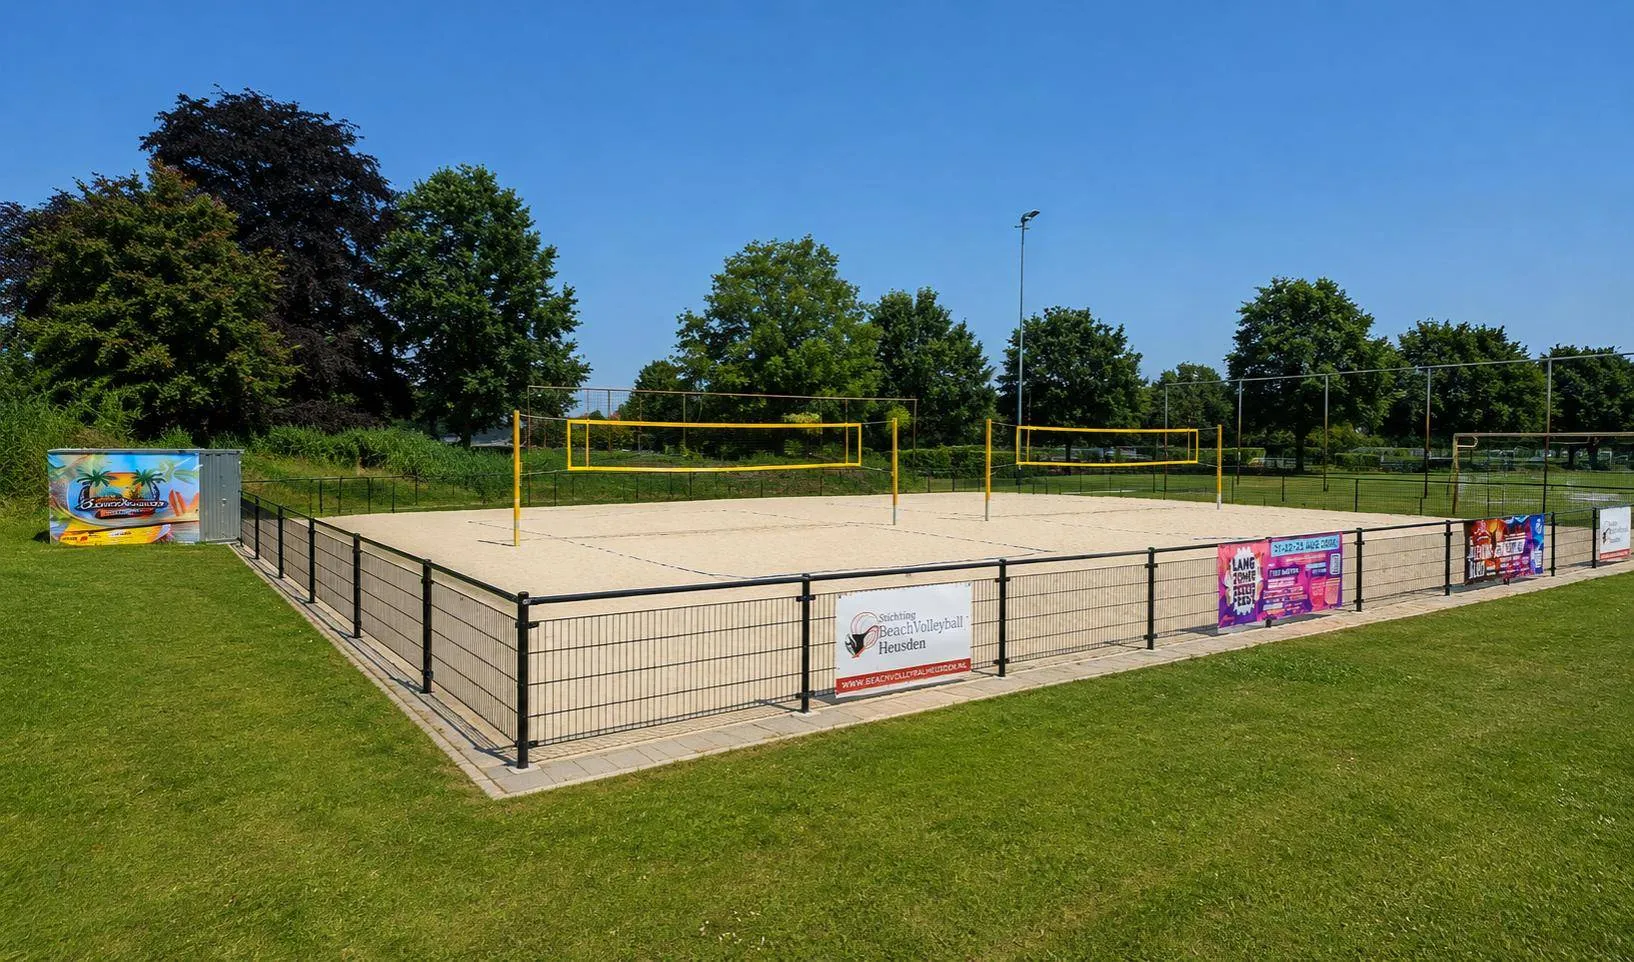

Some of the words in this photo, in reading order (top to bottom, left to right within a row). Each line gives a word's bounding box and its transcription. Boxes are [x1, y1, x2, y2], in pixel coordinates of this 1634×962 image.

[1232, 556, 1255, 571] LANG
[880, 611, 916, 622] Stichting
[880, 616, 963, 638] BeachVolleyball
[879, 638, 926, 655] Heusden
